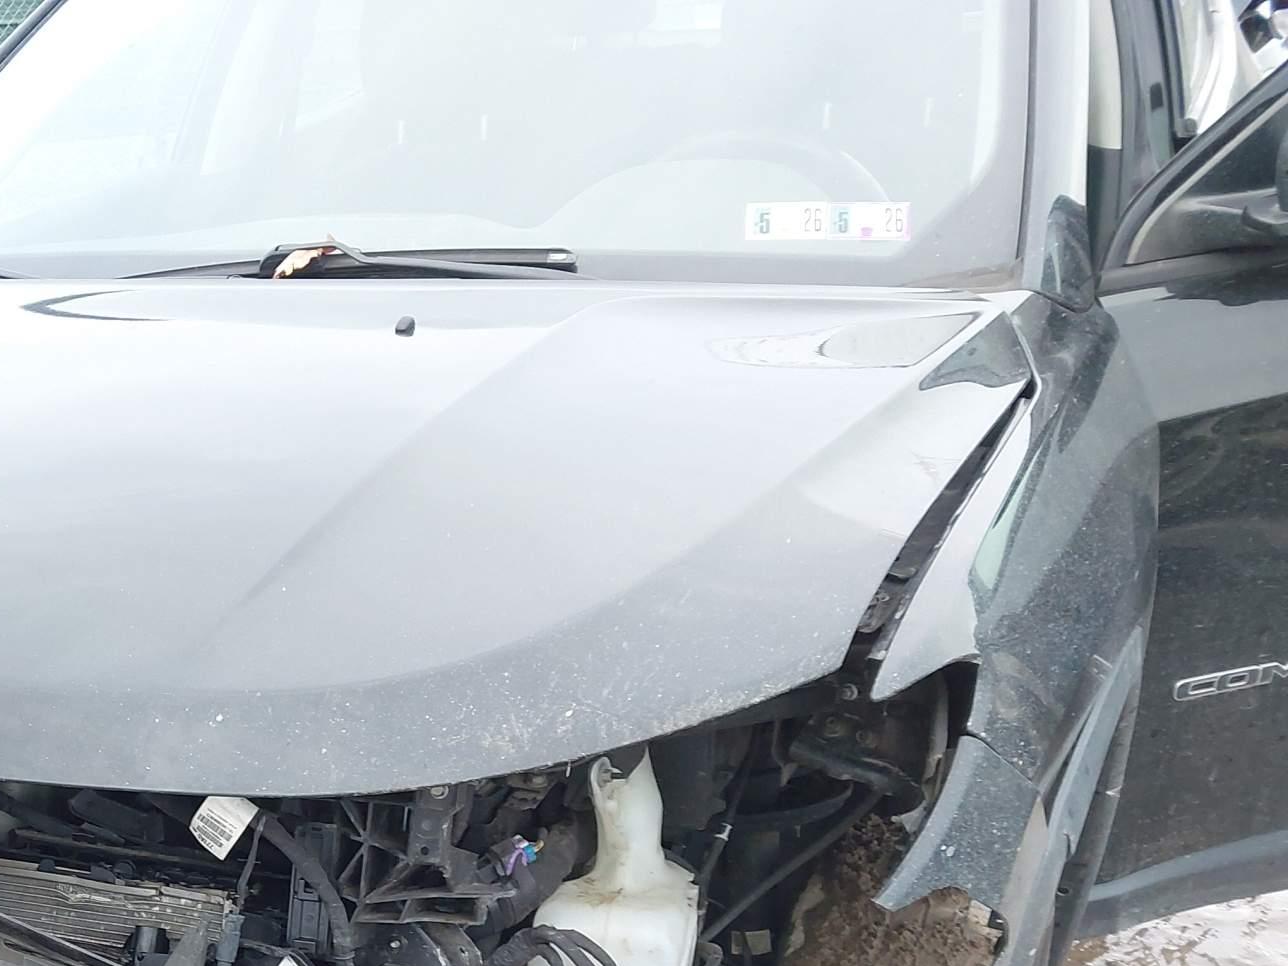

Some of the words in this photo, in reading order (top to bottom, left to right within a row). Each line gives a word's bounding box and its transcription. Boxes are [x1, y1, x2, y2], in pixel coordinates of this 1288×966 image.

[758, 211, 771, 234] 5
[803, 207, 822, 233] 26
[837, 211, 849, 234] 5
[884, 207, 904, 233] 26
